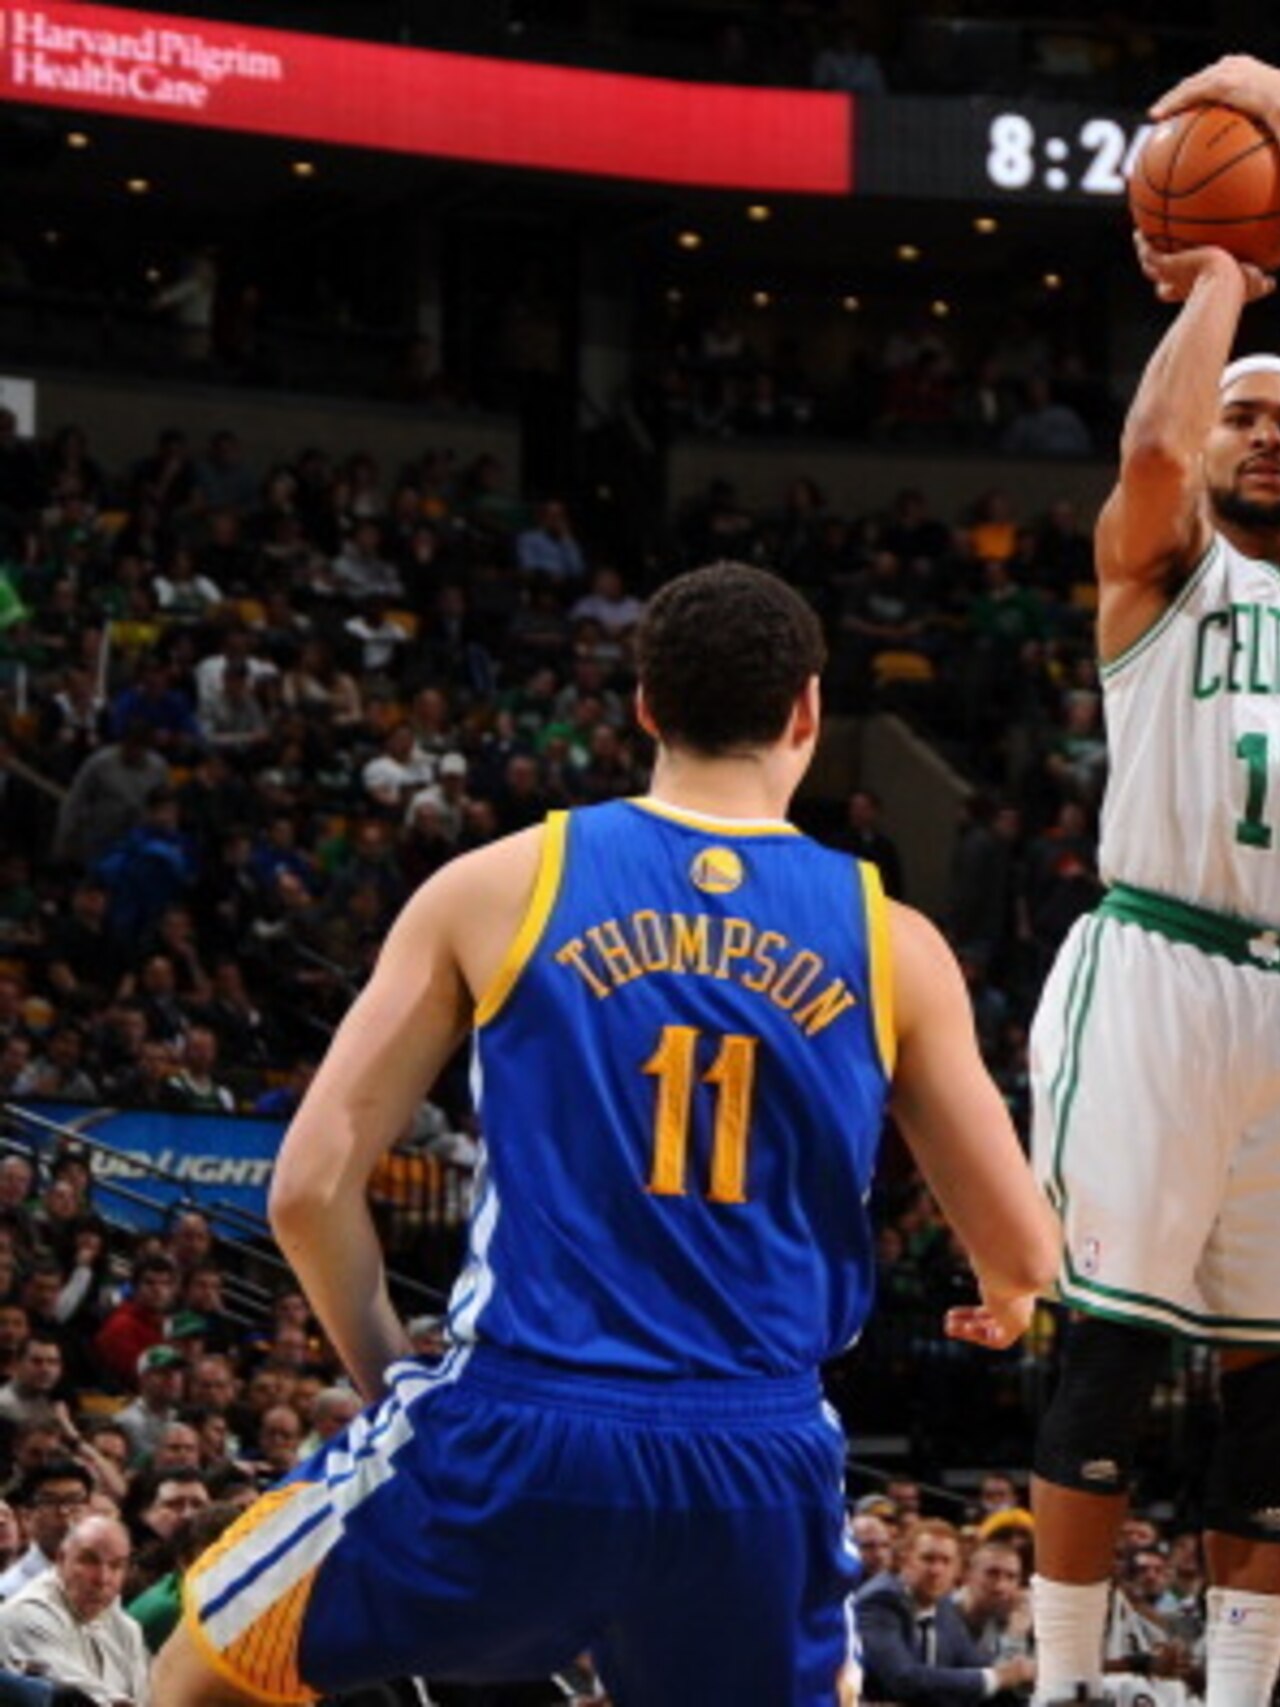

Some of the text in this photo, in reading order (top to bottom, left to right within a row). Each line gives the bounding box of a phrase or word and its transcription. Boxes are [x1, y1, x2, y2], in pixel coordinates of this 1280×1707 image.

[12, 10, 282, 83] Harvard Pilgrim
[554, 908, 856, 1037] THOMPSON
[641, 1023, 759, 1205] 11
[155, 1149, 276, 1186] LIGHT
